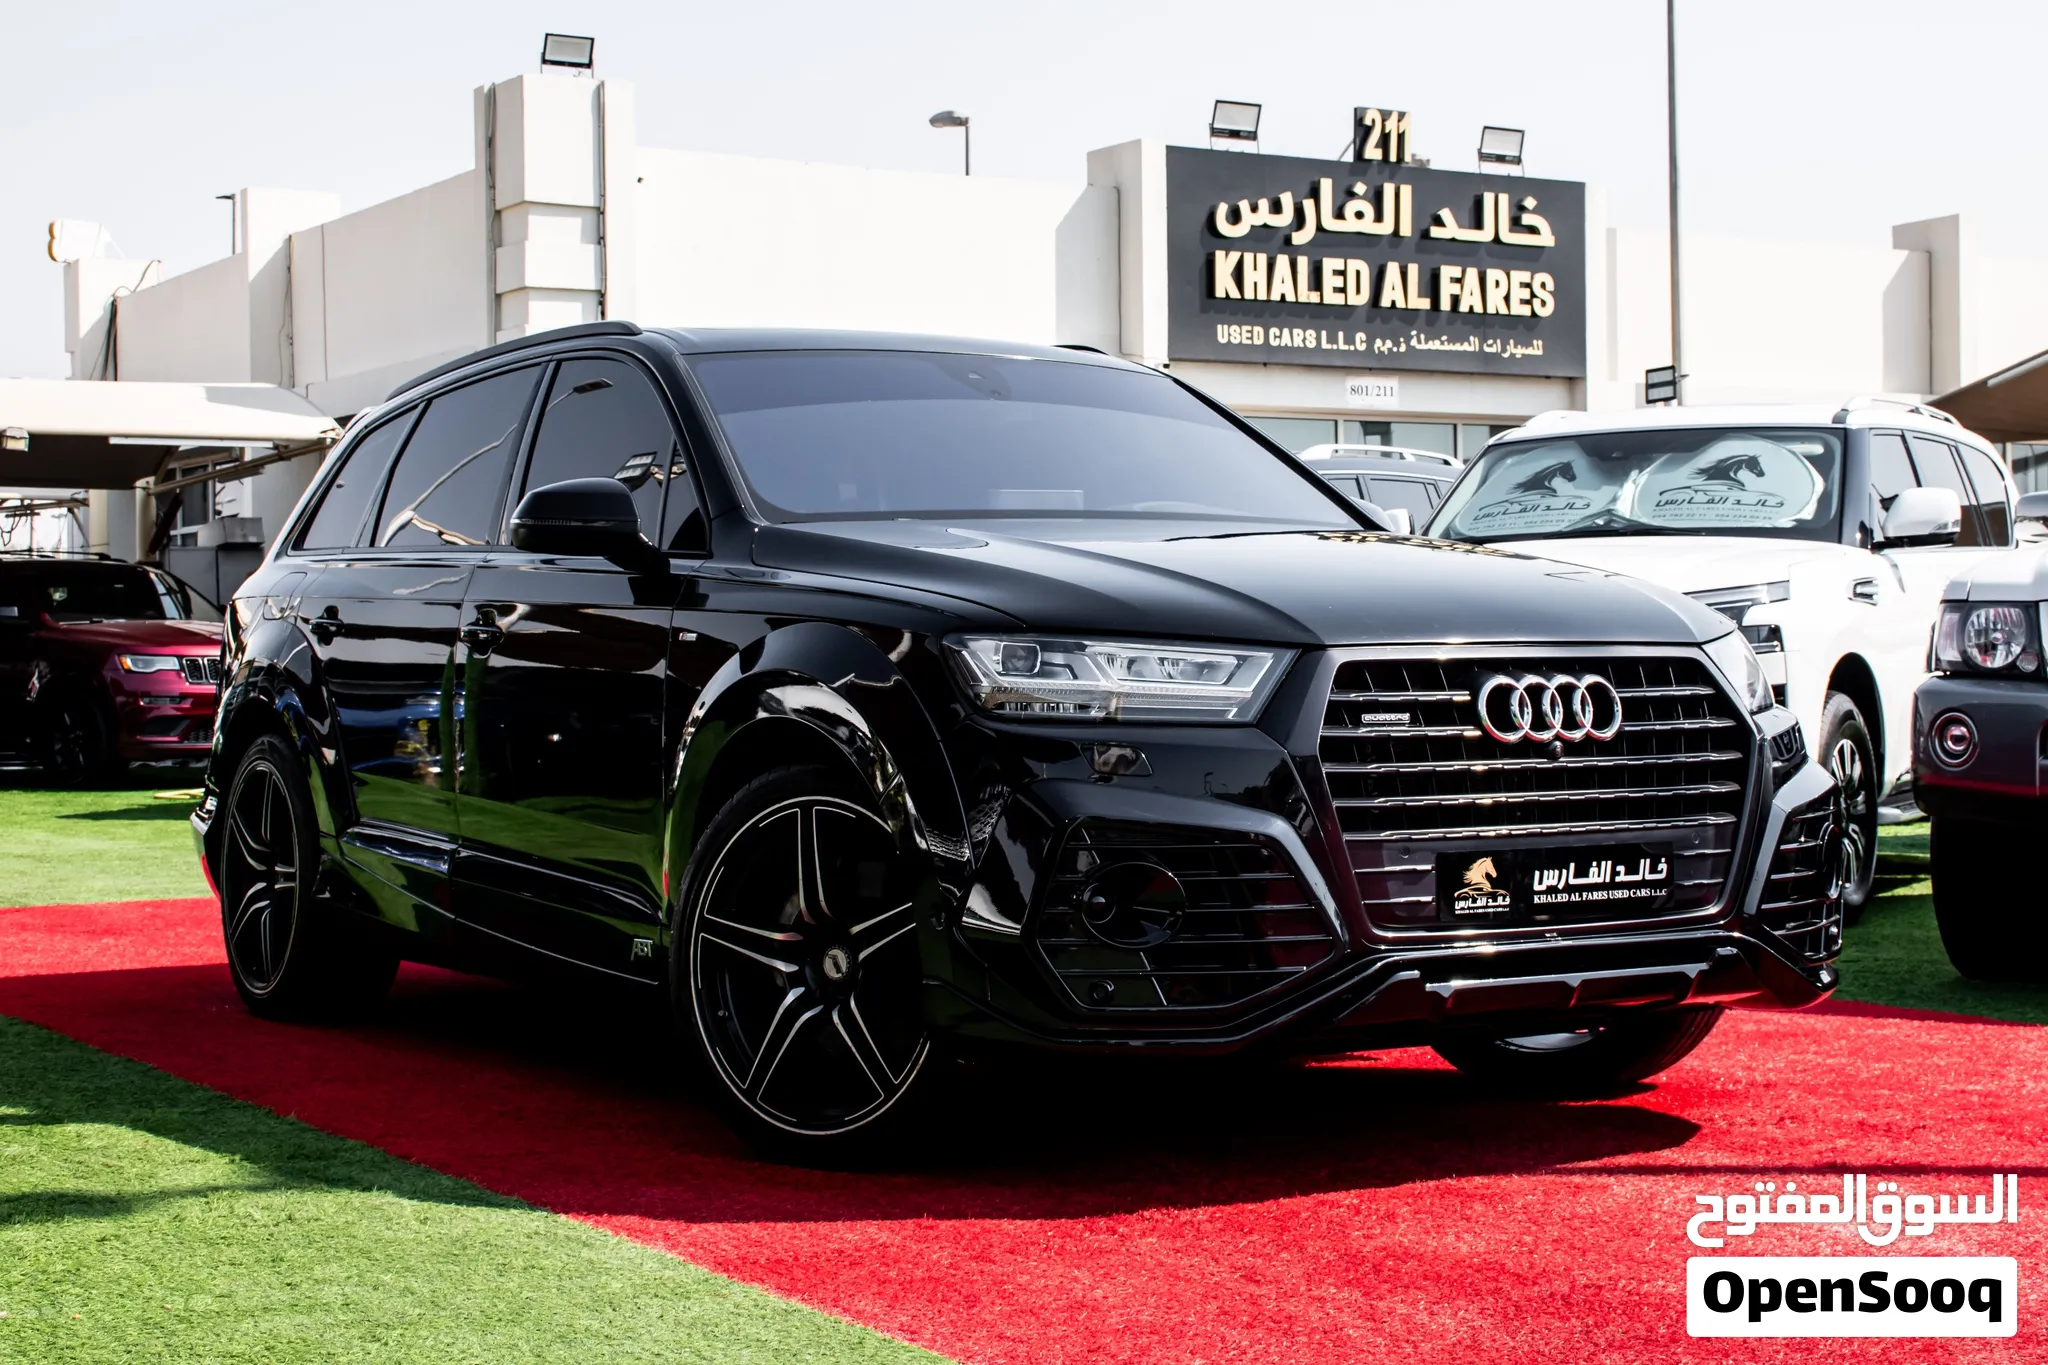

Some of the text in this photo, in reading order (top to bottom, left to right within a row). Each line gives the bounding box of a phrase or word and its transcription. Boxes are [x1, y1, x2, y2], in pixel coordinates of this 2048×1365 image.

[1363, 108, 1412, 163] 211
[1215, 177, 1556, 247] خالد الفارس
[1214, 249, 1556, 318] KHALED AL FARES
[1216, 324, 1368, 352] USED CARS L.L.C
[1409, 329, 1480, 353] المستعملة
[1482, 337, 1544, 359] للسيارات
[1349, 384, 1395, 397] 801/211
[1654, 496, 1785, 509] خالد الفارس
[1533, 857, 1668, 892] خالد الفارس
[1533, 892, 1569, 904] KHALED
[1569, 892, 1582, 902] AL
[1582, 890, 1609, 901] FARES
[1608, 889, 1630, 900] USED
[1630, 887, 1651, 898] CARS
